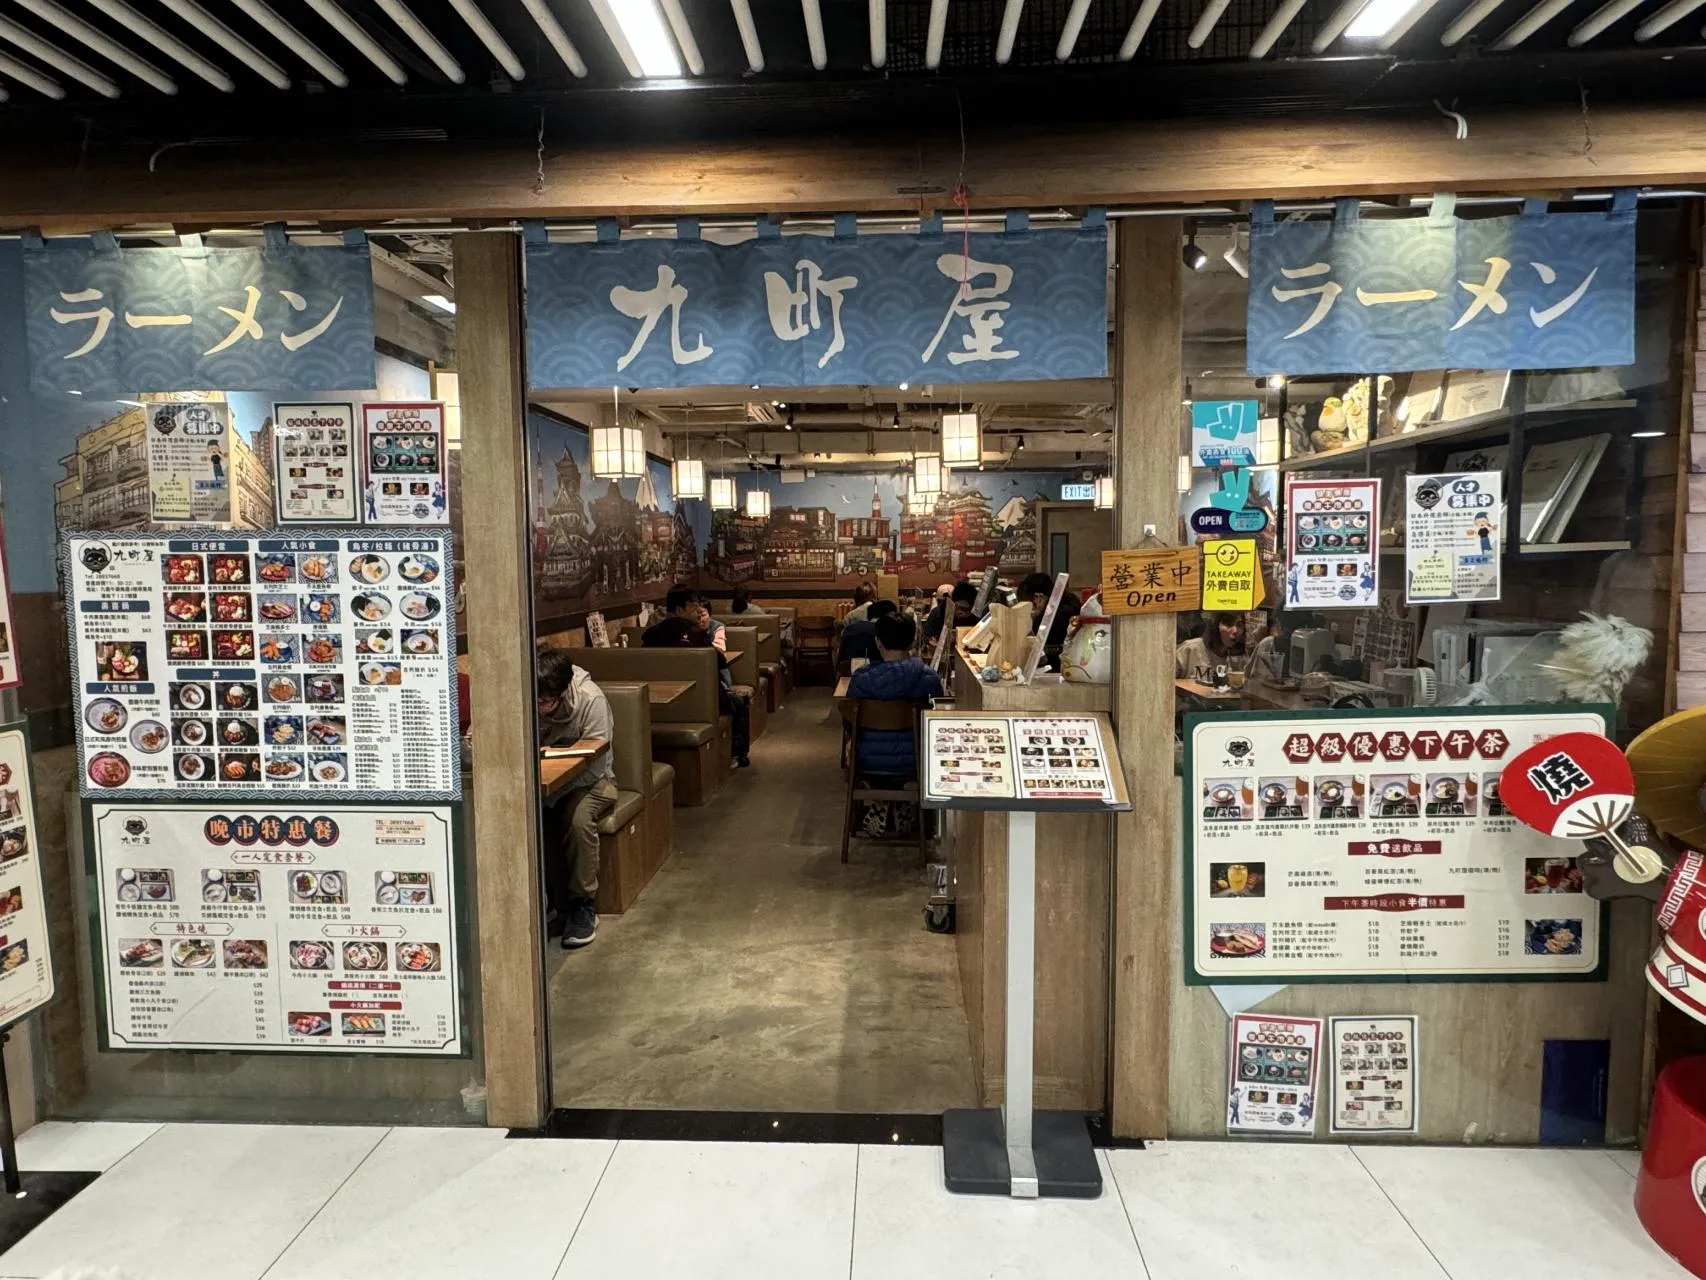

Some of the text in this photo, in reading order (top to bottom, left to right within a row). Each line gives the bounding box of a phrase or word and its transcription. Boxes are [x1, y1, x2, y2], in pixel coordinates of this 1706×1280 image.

[1271, 256, 1599, 340] ラーメン
[609, 253, 1020, 372] 九町屋
[49, 284, 344, 360] ラーメン
[1064, 486, 1081, 498] EXIT
[1198, 515, 1223, 526] OPEN
[281, 542, 317, 550] 人氣小食
[113, 549, 156, 562] 九町屋
[1110, 559, 1193, 592] 營業中
[1206, 570, 1252, 578] TAKEAWAY
[1206, 579, 1252, 592] 外賣自取
[1126, 590, 1178, 609] Open
[1288, 731, 1505, 758] 超級優惠下午茶
[209, 820, 333, 840] 晚市特惠餐
[1367, 843, 1424, 854] 免費送飲品
